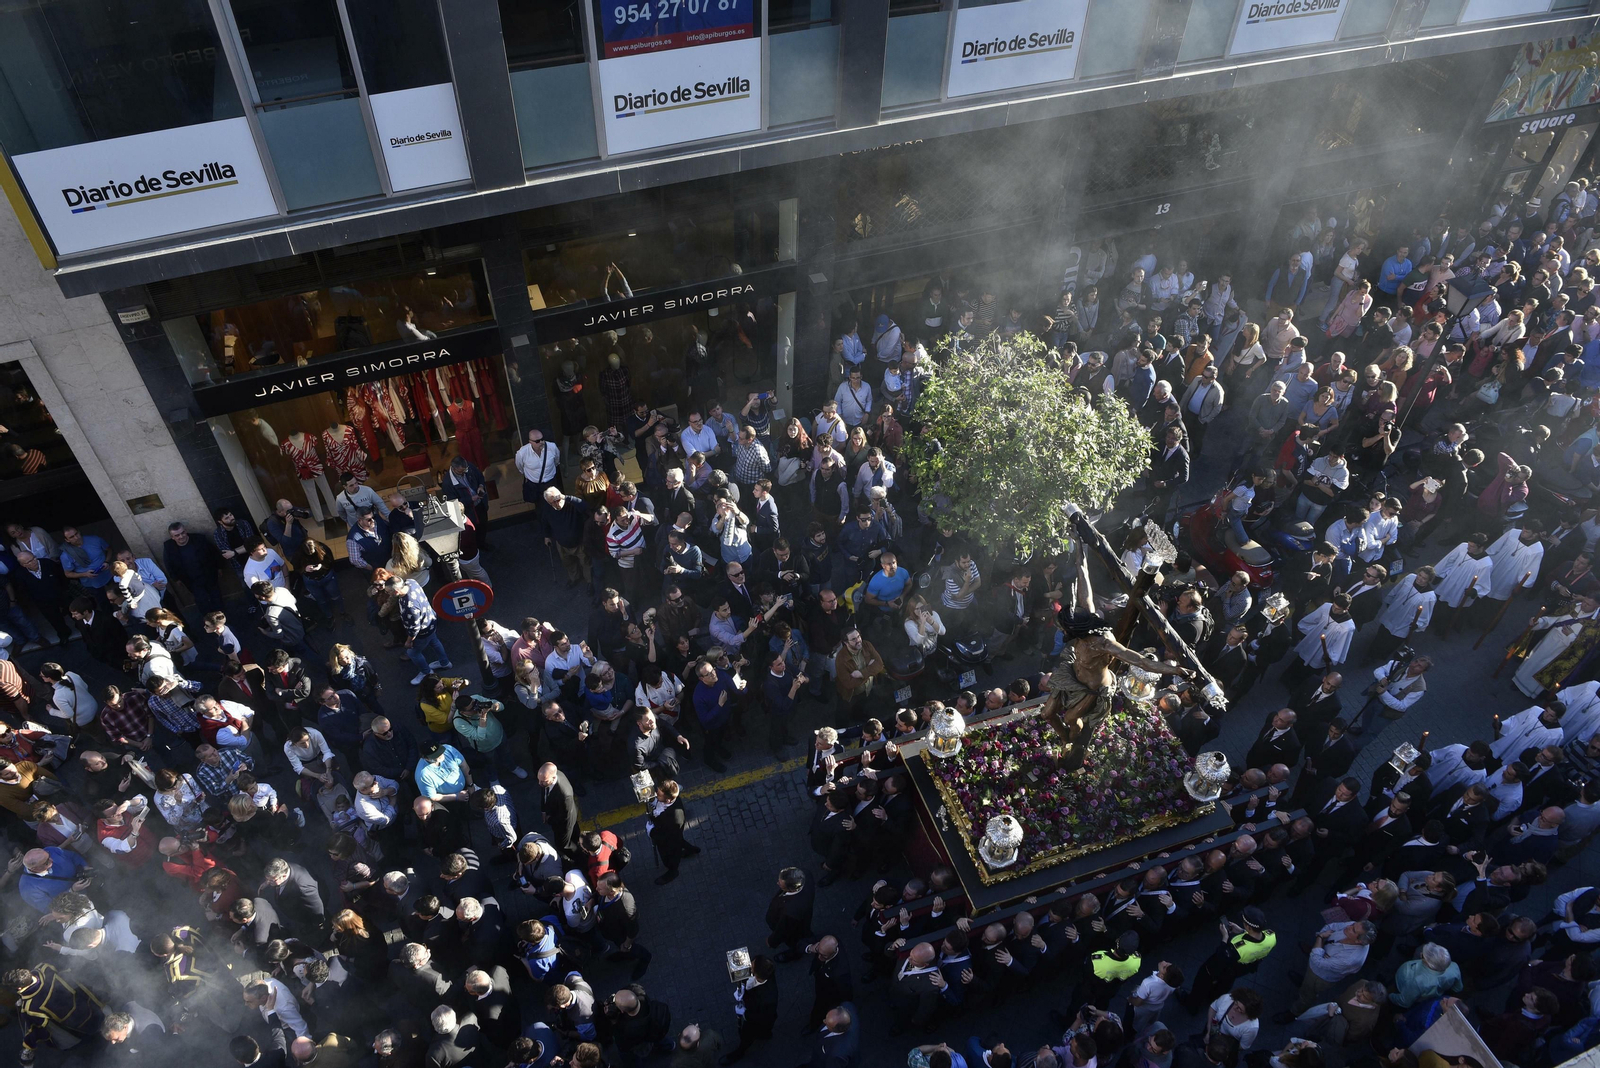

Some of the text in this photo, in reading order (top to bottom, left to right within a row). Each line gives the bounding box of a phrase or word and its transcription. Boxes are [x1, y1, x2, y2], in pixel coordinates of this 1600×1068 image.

[614, 2, 652, 25] 954
[657, 0, 679, 19] 27
[688, 0, 707, 15] 07
[1247, 0, 1340, 19] Diario de Sevilla
[612, 28, 746, 52] www.apiburgos.es info@apiburgos.es
[961, 28, 1075, 58] Diario de Sevilla
[613, 76, 750, 113] Diario de Sevilla
[1519, 113, 1576, 134] square
[390, 129, 452, 146] Diario de Sevilla
[62, 161, 236, 207] Diario de Sevilla
[1155, 203, 1171, 215] 13
[584, 284, 755, 327] JAVIER SIMORRA
[254, 348, 451, 398] JAVIER SIMORRA
[456, 606, 477, 614] MOTOS
[458, 596, 470, 608] P
